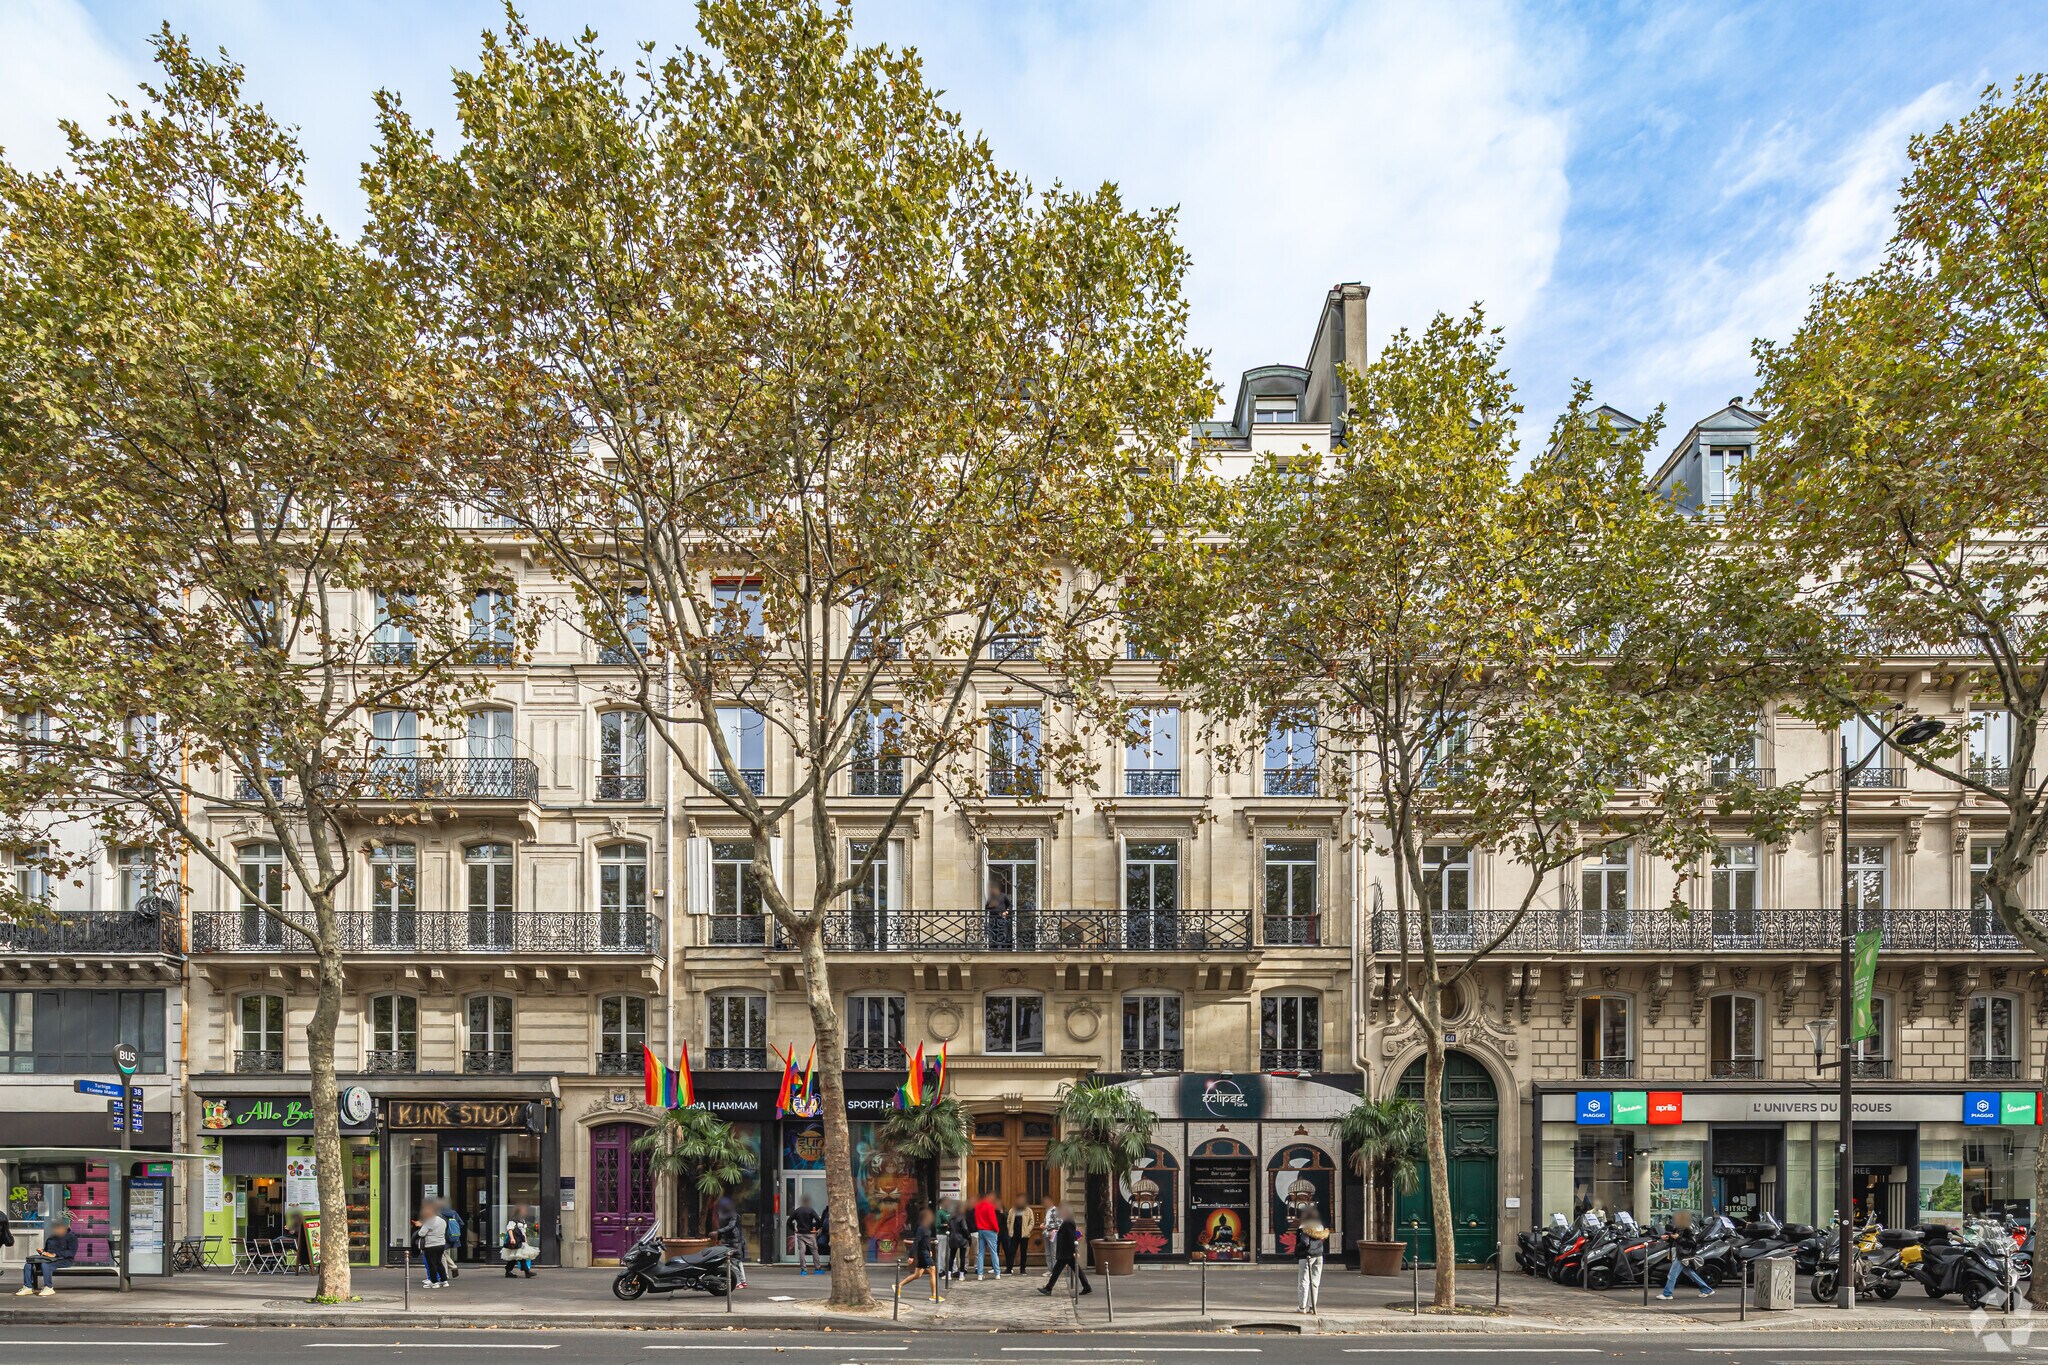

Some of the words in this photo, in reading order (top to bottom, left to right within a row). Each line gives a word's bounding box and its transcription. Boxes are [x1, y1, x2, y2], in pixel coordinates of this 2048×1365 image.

[119, 1050, 136, 1062] BUS
[712, 1101, 758, 1110] HAMMAM
[847, 1100, 880, 1109] SPORT
[1655, 1104, 1677, 1112] aprilia
[1764, 1102, 1818, 1113] UNIVERS
[1820, 1102, 1838, 1112] DU
[1851, 1102, 1892, 1113] ROUES
[236, 1101, 282, 1125] Allo
[282, 1102, 314, 1127] Bei
[398, 1105, 450, 1124] KINK
[460, 1105, 519, 1124] STUDY
